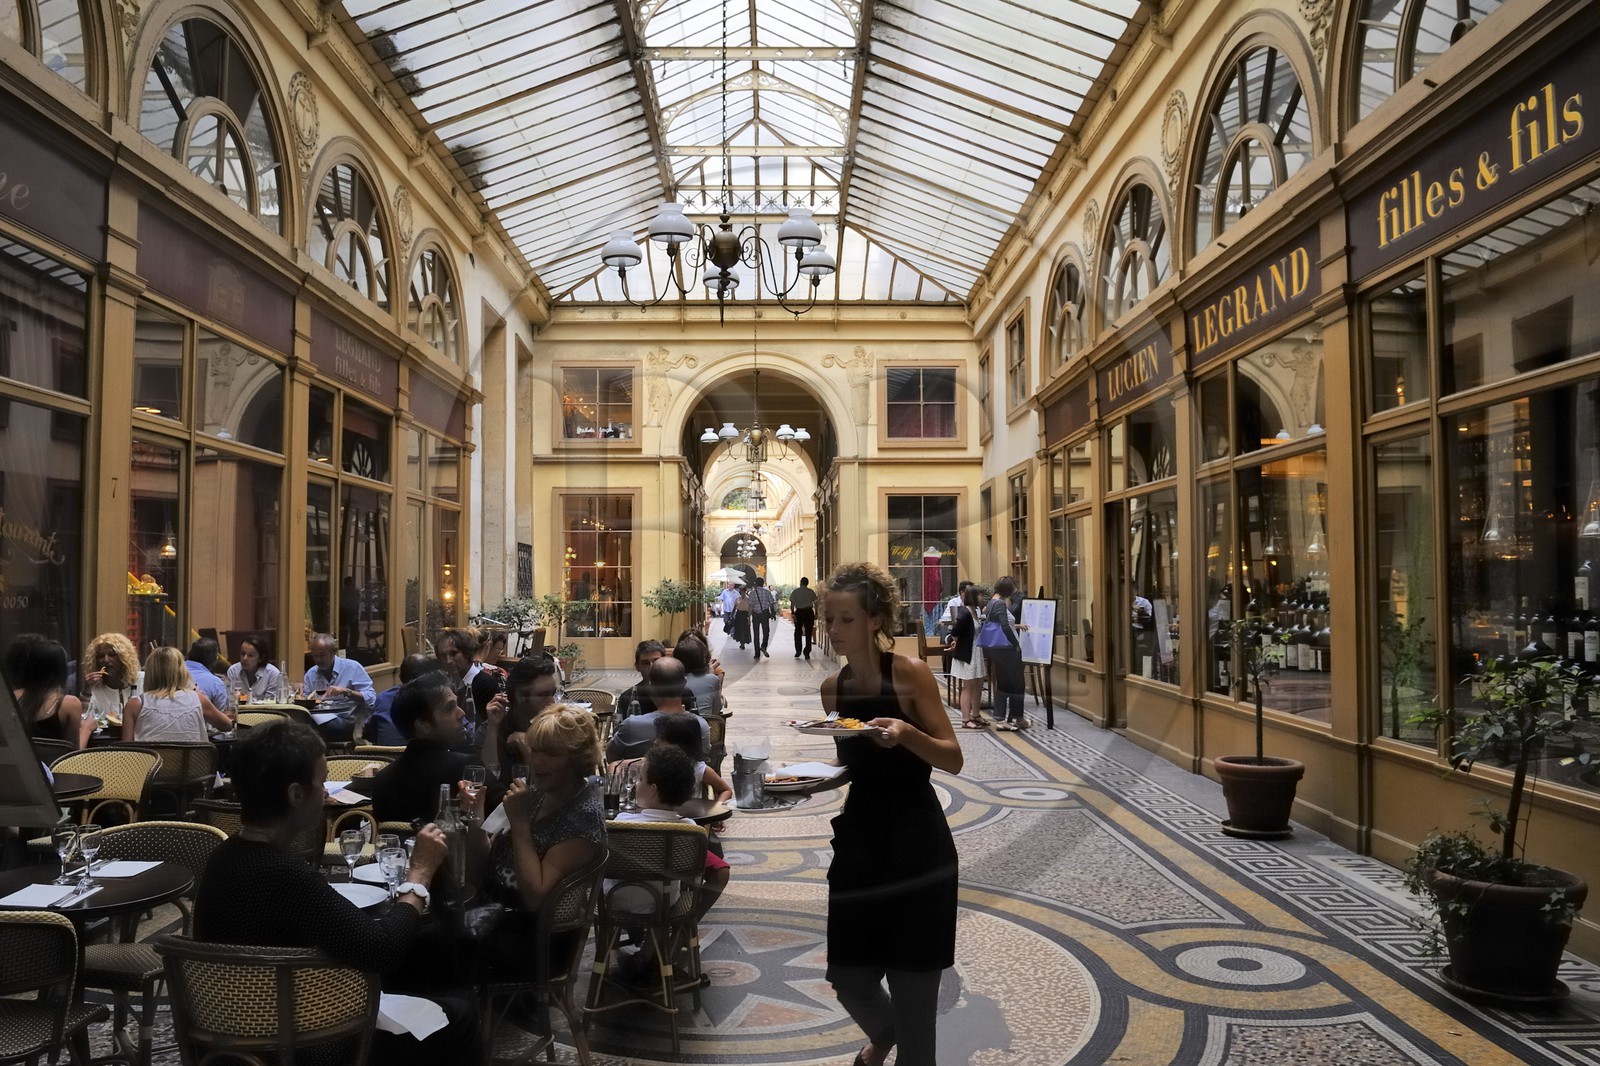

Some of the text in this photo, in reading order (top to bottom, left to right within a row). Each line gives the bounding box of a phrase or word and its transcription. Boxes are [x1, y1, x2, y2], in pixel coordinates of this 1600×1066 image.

[1377, 83, 1585, 249] filles & fils
[1192, 247, 1310, 355] LEGRAND
[1108, 341, 1159, 401] LUCIEN
[111, 477, 119, 499] 7
